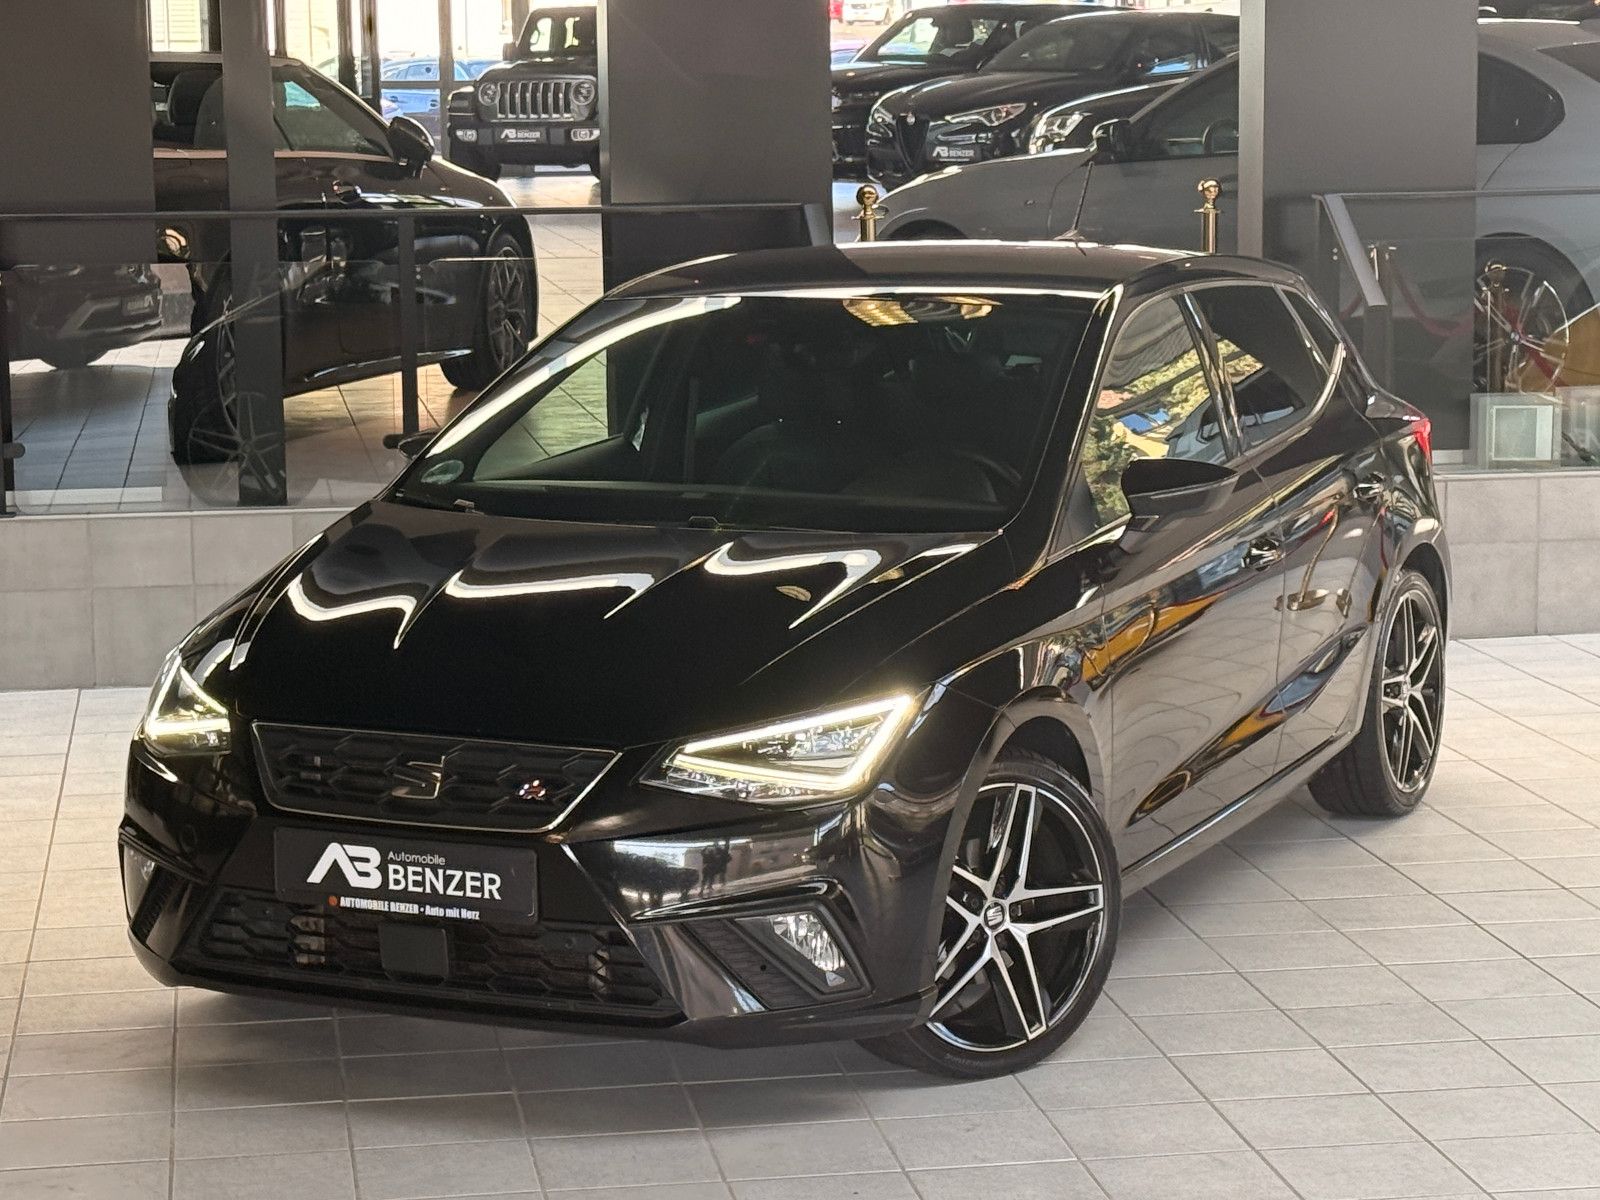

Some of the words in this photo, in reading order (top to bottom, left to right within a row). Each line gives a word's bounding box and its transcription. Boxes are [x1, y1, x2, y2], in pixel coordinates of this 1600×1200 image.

[387, 850, 446, 866] Automobile
[387, 863, 502, 901] BENZER
[340, 896, 390, 912] AUTOMOBILE
[389, 901, 419, 915] BENZER
[425, 904, 445, 917] Auto
[445, 907, 460, 919] mit
[460, 908, 480, 920] Herz
